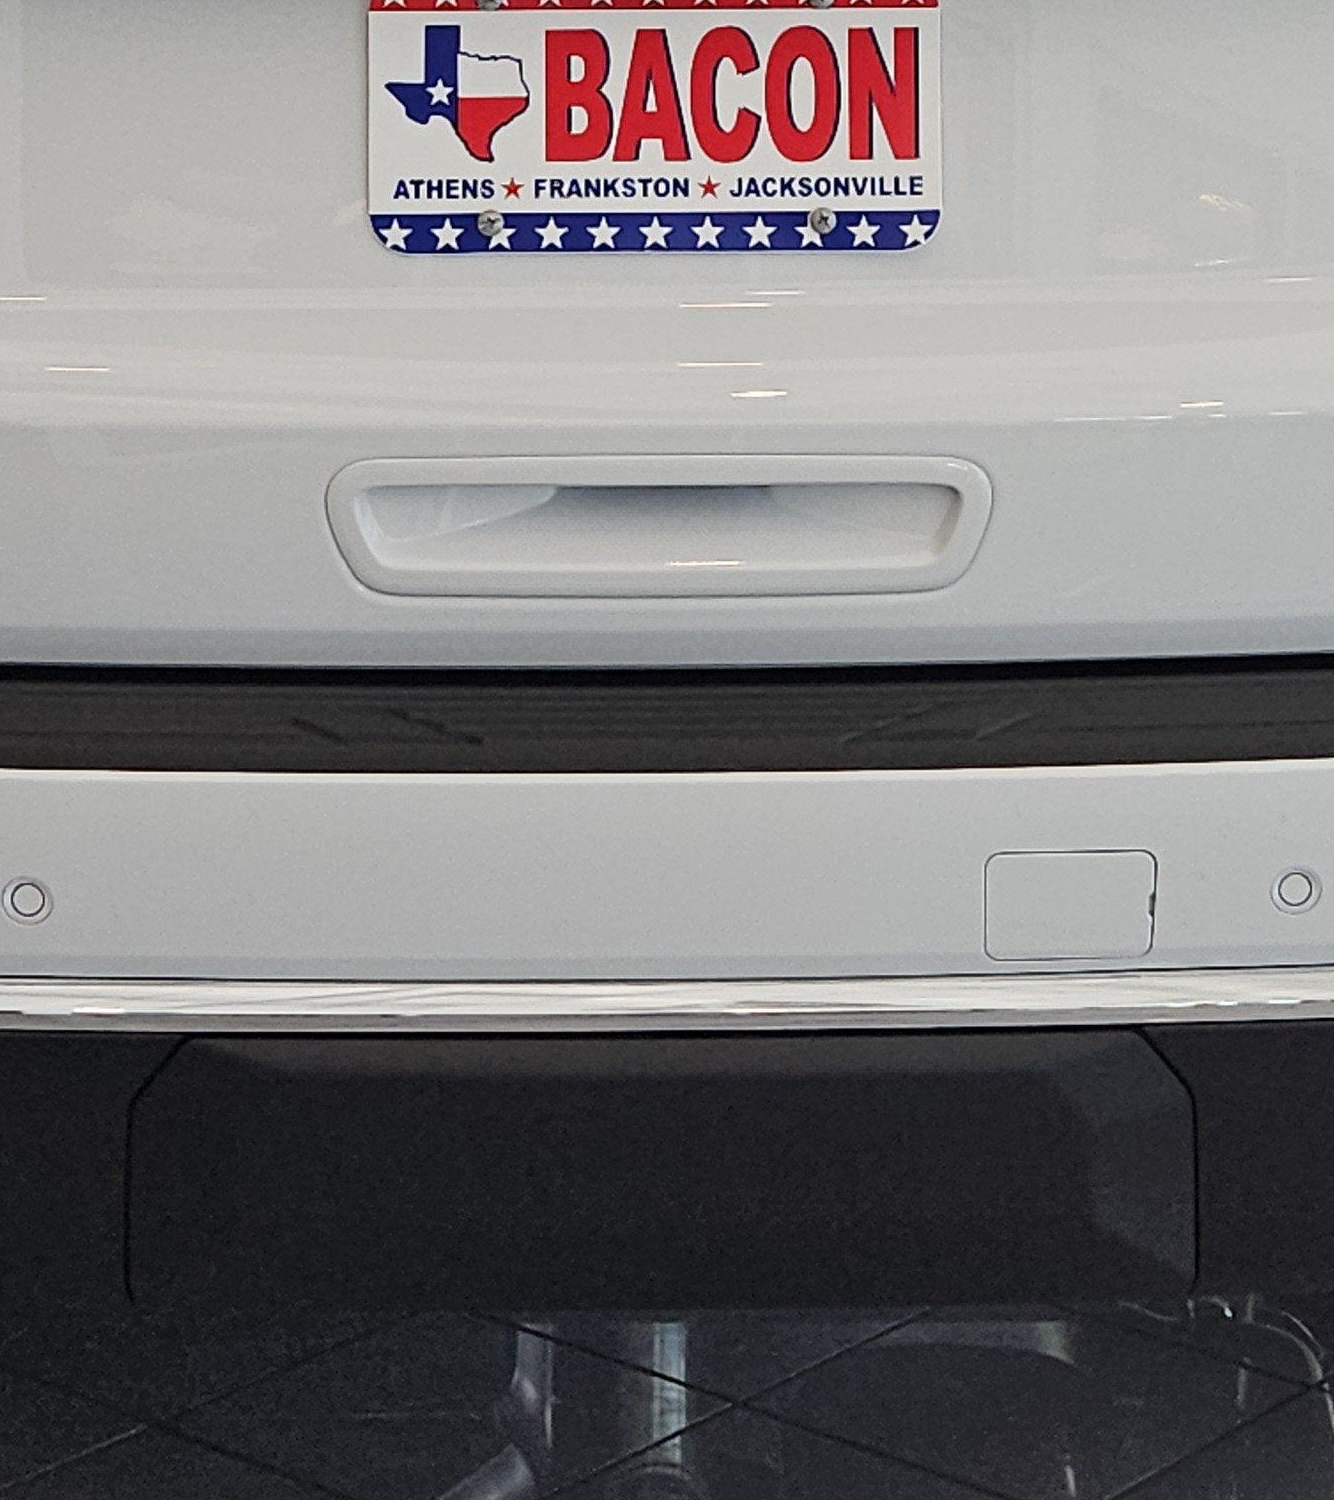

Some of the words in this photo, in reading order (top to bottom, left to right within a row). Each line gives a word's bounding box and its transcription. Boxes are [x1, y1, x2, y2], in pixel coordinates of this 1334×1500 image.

[545, 25, 919, 163] BACON
[393, 179, 495, 200] ATHENS
[534, 178, 689, 199] FRANKSTON
[729, 176, 924, 199] JACKSONVILLE
